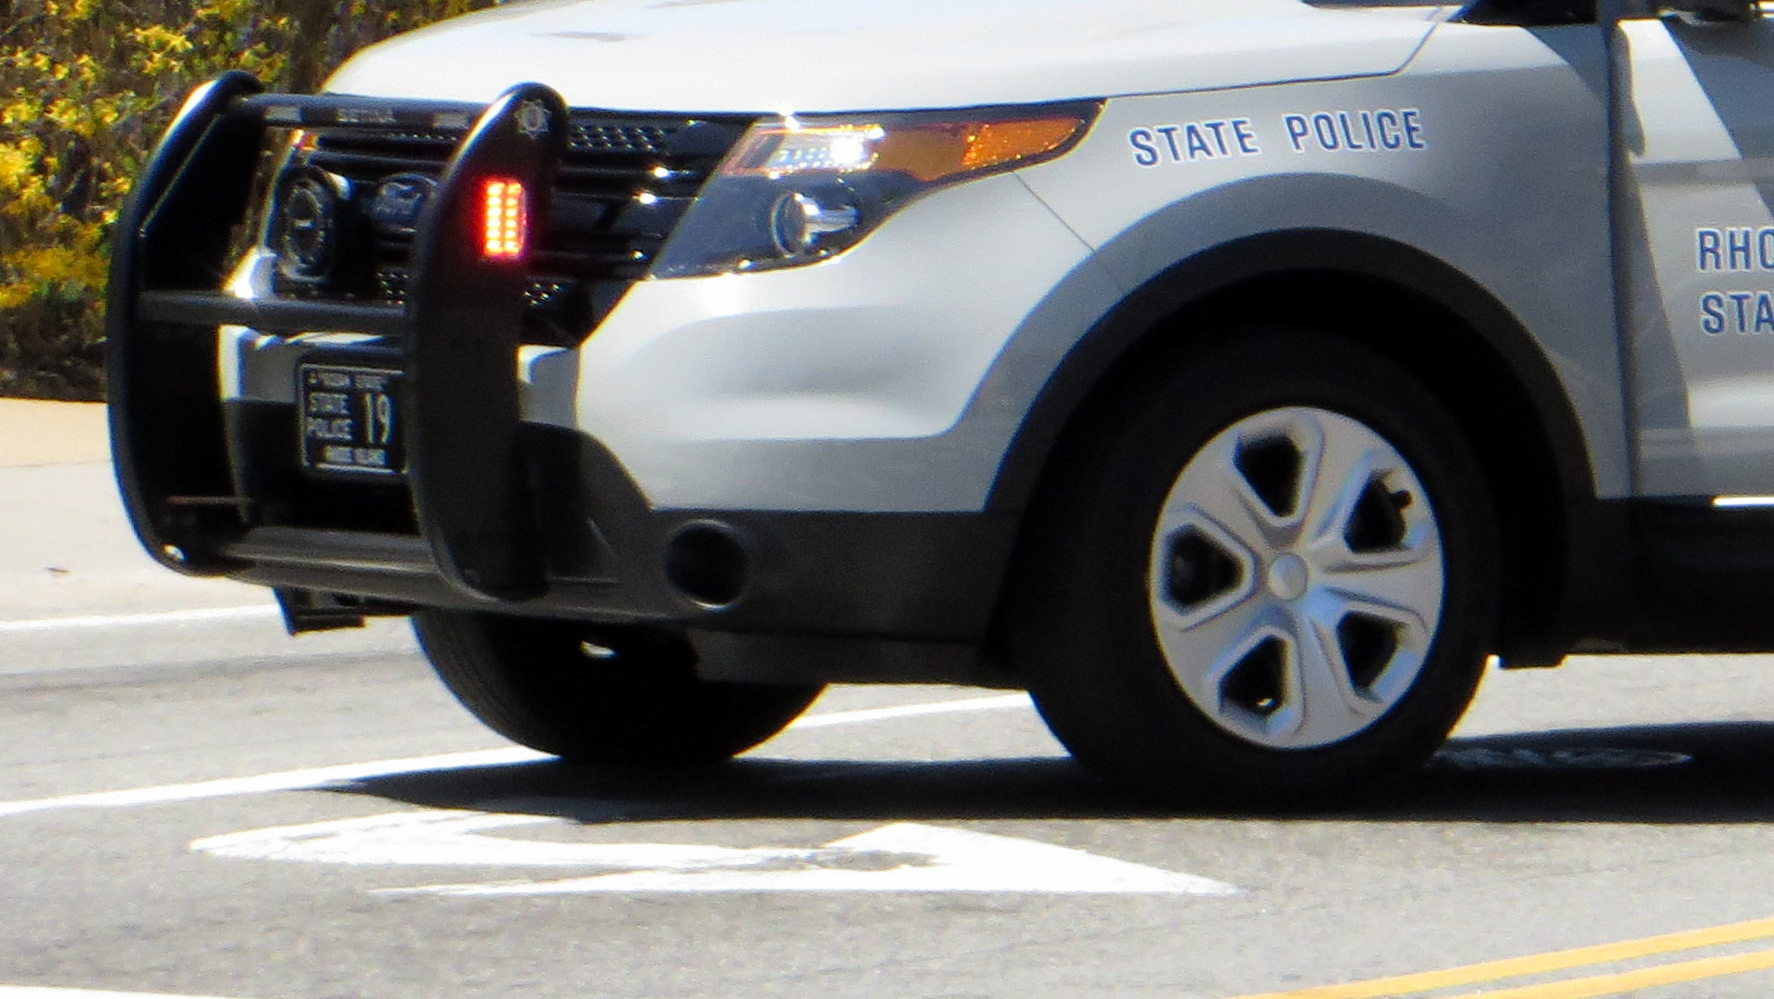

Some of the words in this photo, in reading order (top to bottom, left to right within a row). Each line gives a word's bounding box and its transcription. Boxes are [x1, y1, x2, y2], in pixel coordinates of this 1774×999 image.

[1129, 118, 1260, 166] STATE
[1283, 109, 1426, 151] POLICE
[363, 392, 391, 443] 19
